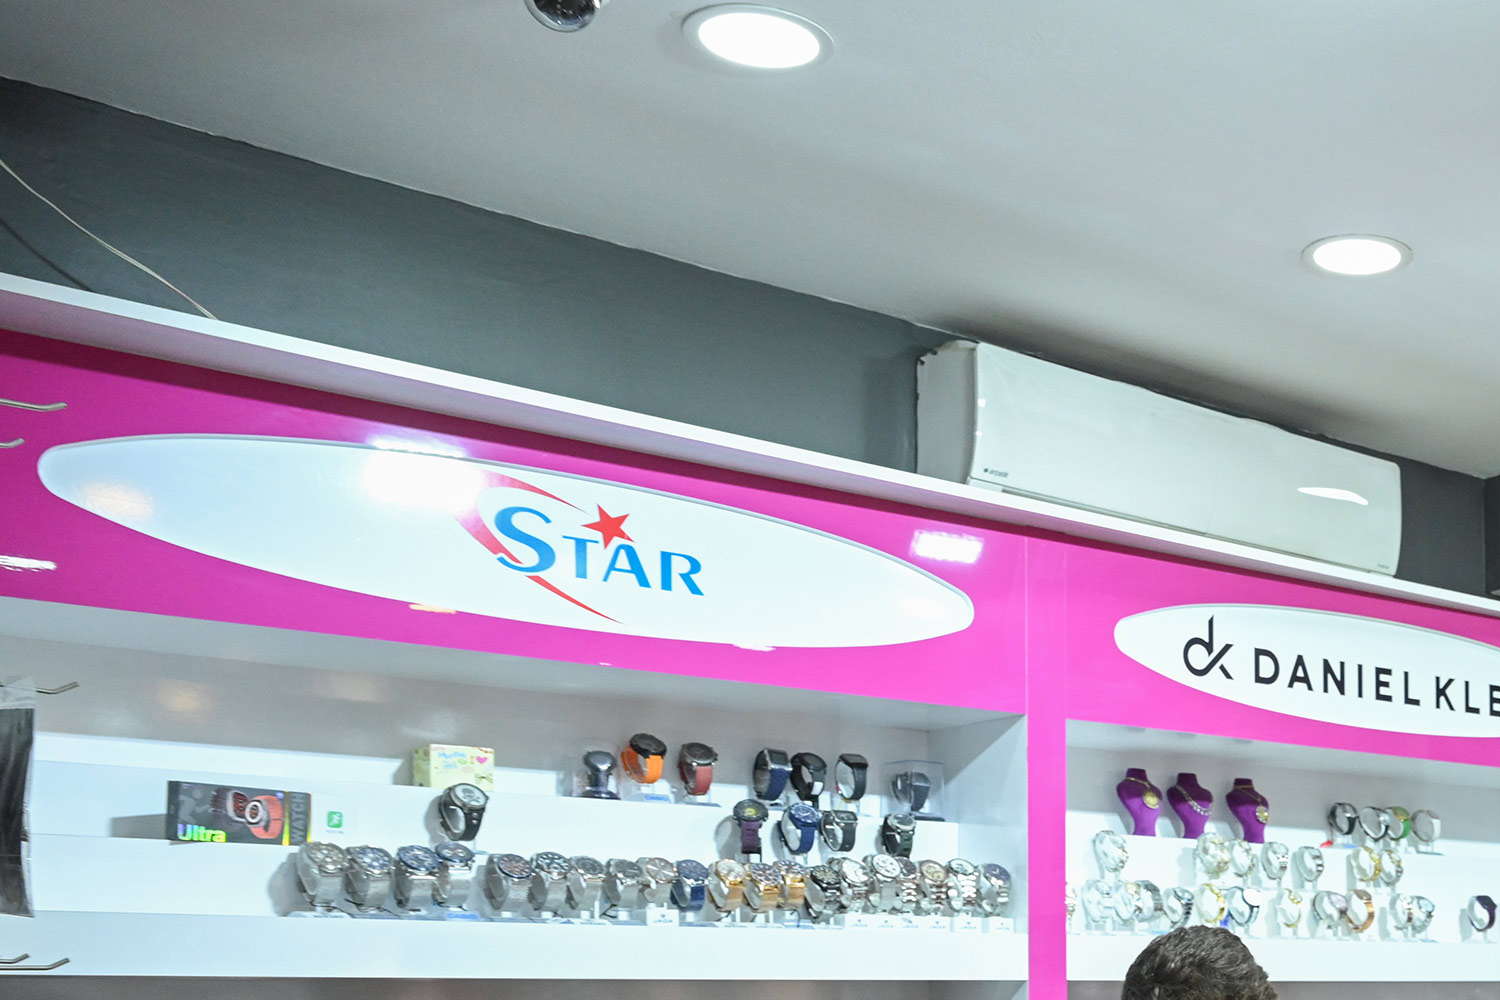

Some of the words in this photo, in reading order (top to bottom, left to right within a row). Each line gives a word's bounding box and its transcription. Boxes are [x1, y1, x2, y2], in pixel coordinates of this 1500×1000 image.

[494, 506, 705, 597] STAR
[1254, 647, 1421, 707] DANIEL
[177, 823, 227, 843] Ultra
